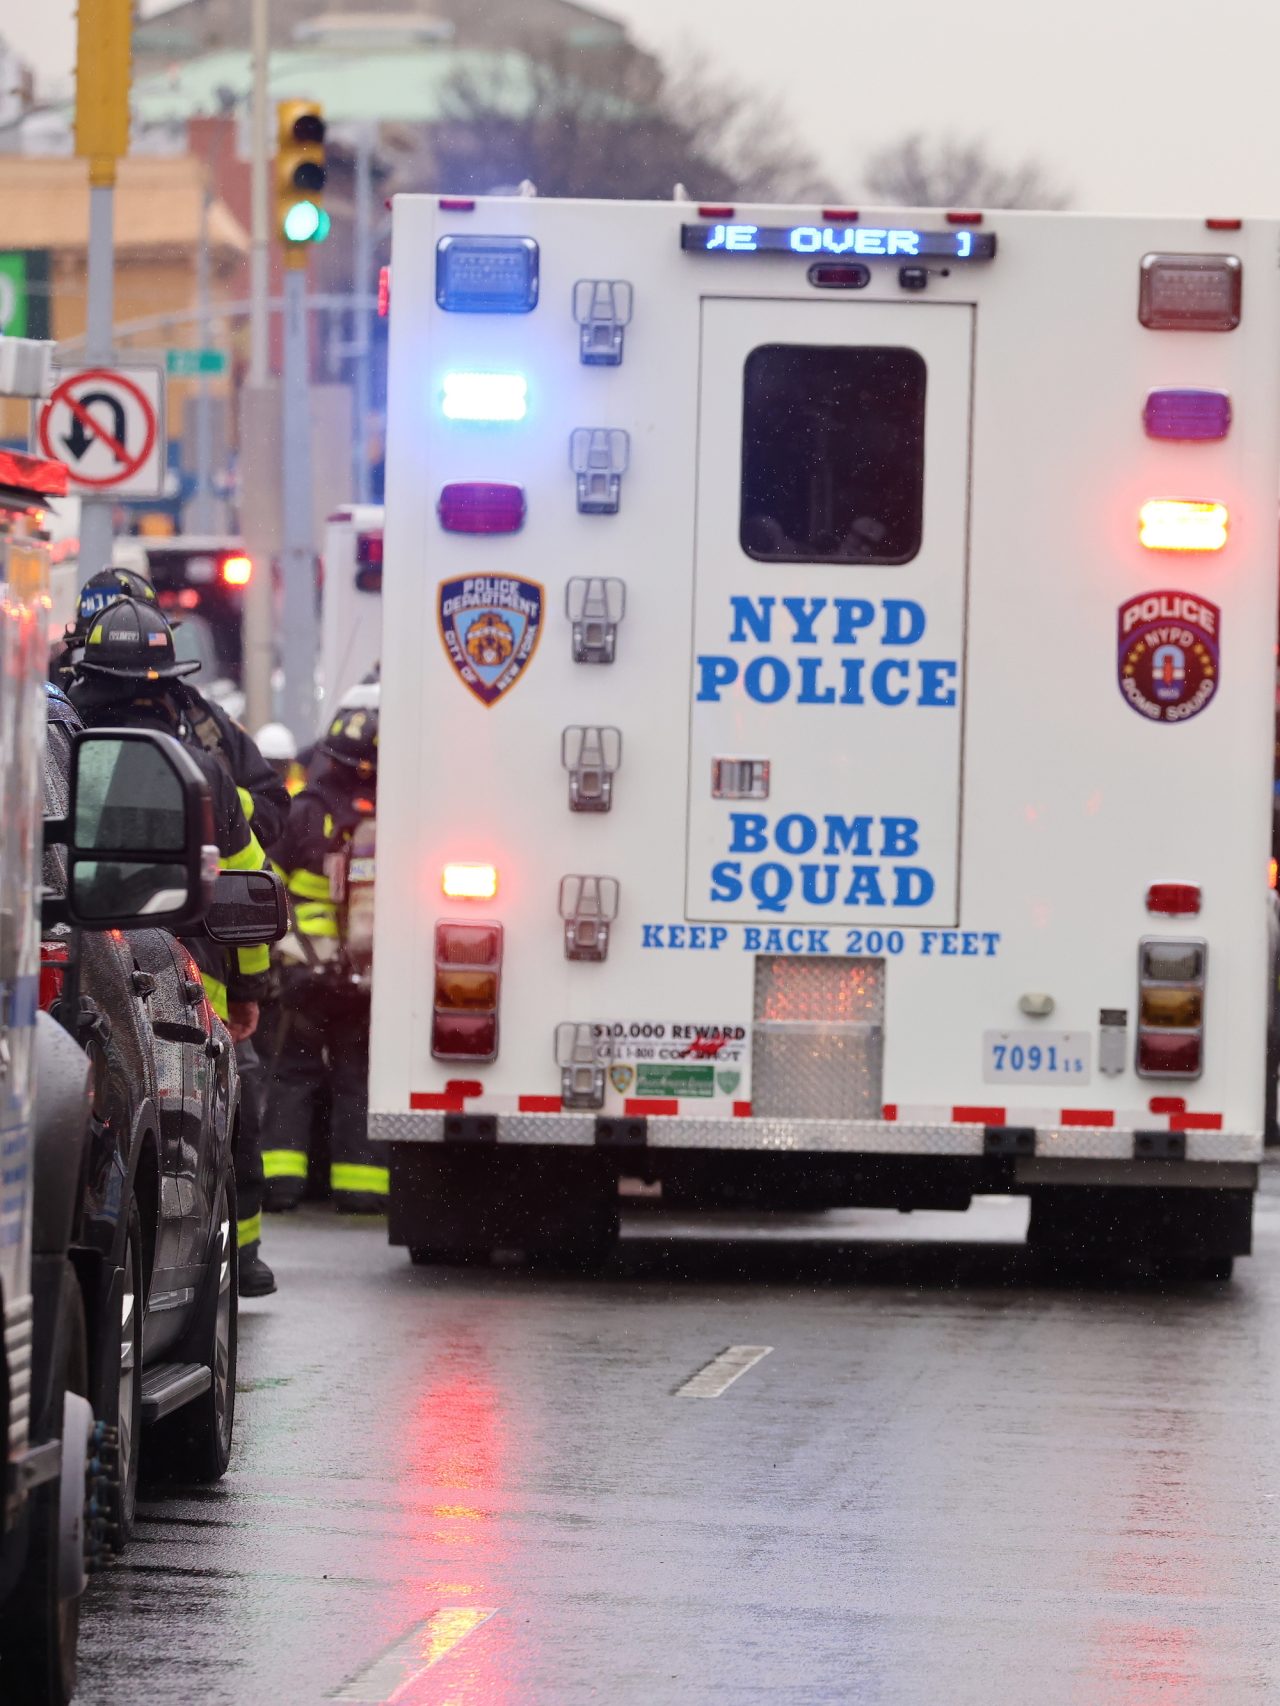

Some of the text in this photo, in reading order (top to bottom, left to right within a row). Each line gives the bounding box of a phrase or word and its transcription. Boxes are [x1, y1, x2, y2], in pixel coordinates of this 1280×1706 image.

[790, 227, 920, 255] OVER
[463, 577, 519, 597] POLICE
[443, 592, 538, 617] DEPARTMENT
[729, 595, 927, 646] NYPD
[1123, 596, 1216, 634] POLICE
[1144, 626, 1195, 648] NYPD
[696, 655, 958, 707] POLICE
[1122, 677, 1215, 721] BOMB SQUAD
[728, 812, 919, 858] BOMB
[710, 860, 936, 913] SQUAD
[641, 924, 1001, 956] KEEP BACK 200 FEET
[672, 1024, 746, 1040] REWARD
[992, 1044, 1058, 1072] 7091
